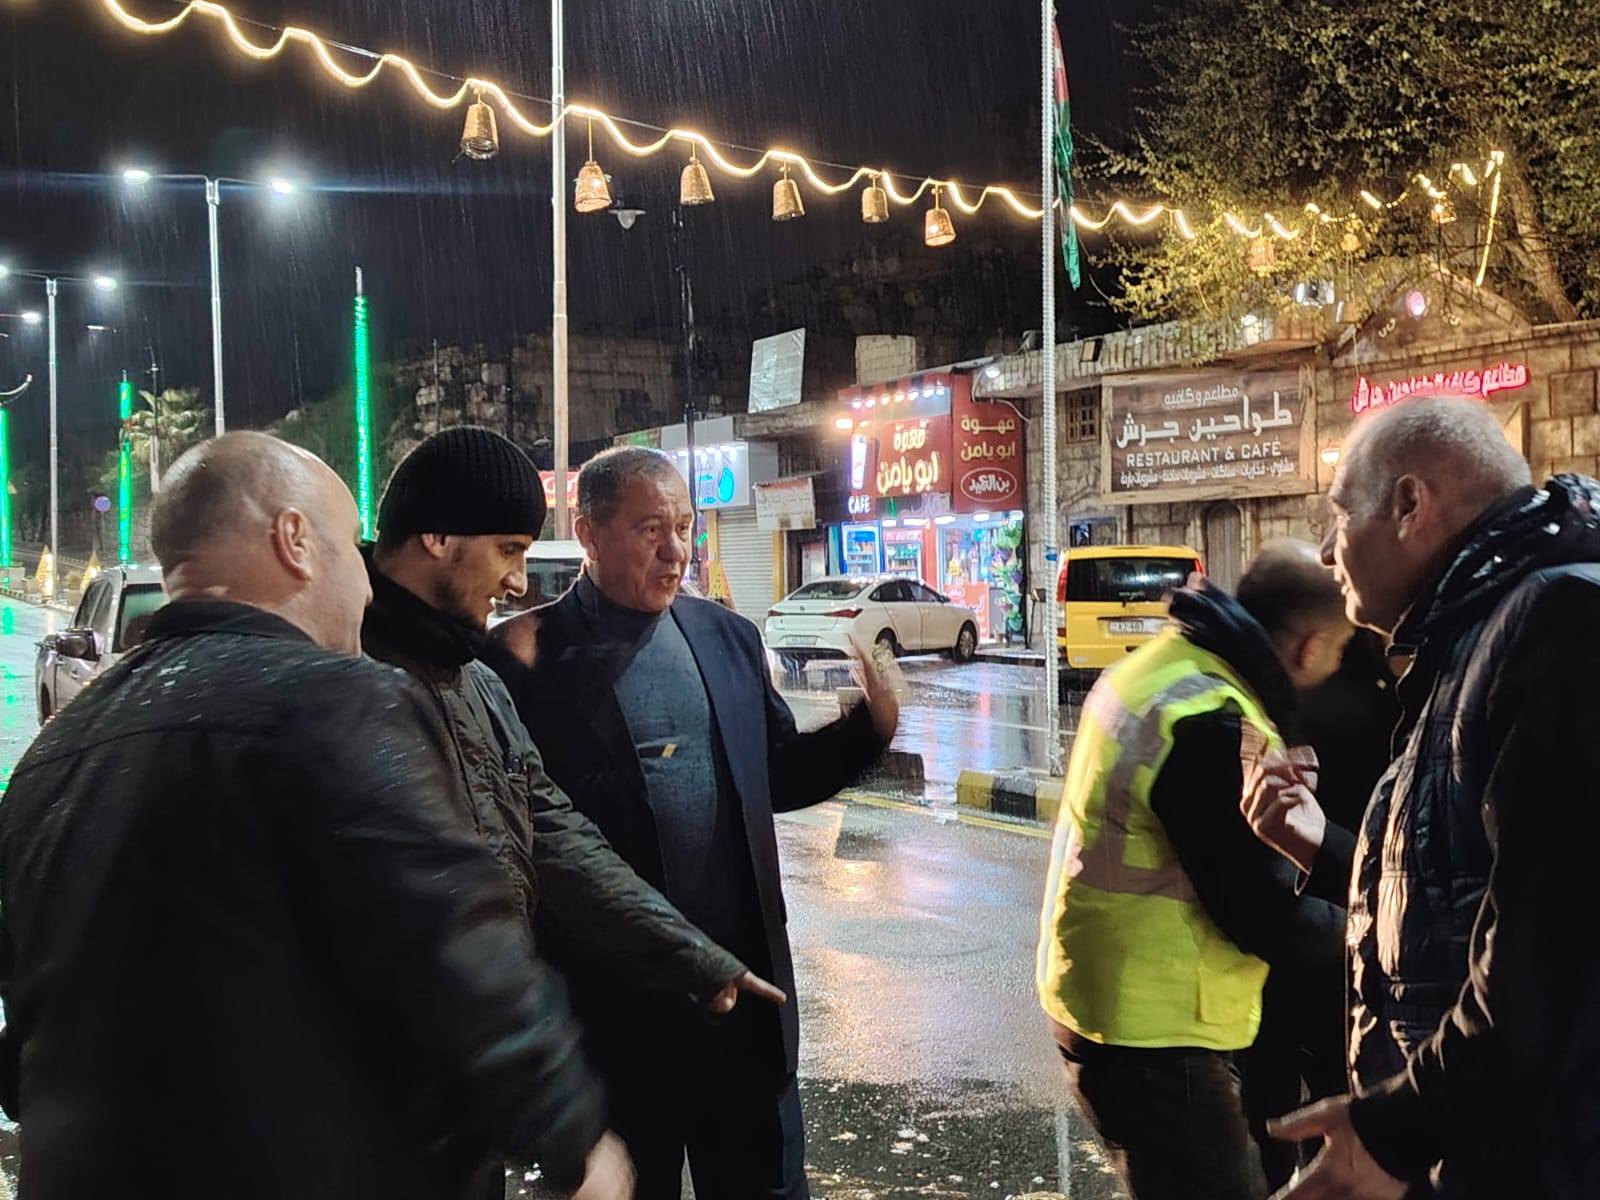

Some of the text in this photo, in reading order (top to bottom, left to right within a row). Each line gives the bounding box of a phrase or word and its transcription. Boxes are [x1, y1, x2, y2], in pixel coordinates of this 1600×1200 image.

[1202, 384, 1239, 407] مطاعم
[961, 415, 1016, 435] قهوة
[1116, 391, 1293, 448] طواحين جرش
[893, 420, 927, 451] قهوة
[960, 442, 1016, 461] ابو يامن
[1126, 446, 1220, 468] RESTAURANT
[1224, 446, 1236, 461] &
[876, 451, 940, 495] ابو يامن
[848, 494, 871, 515] CAFE
